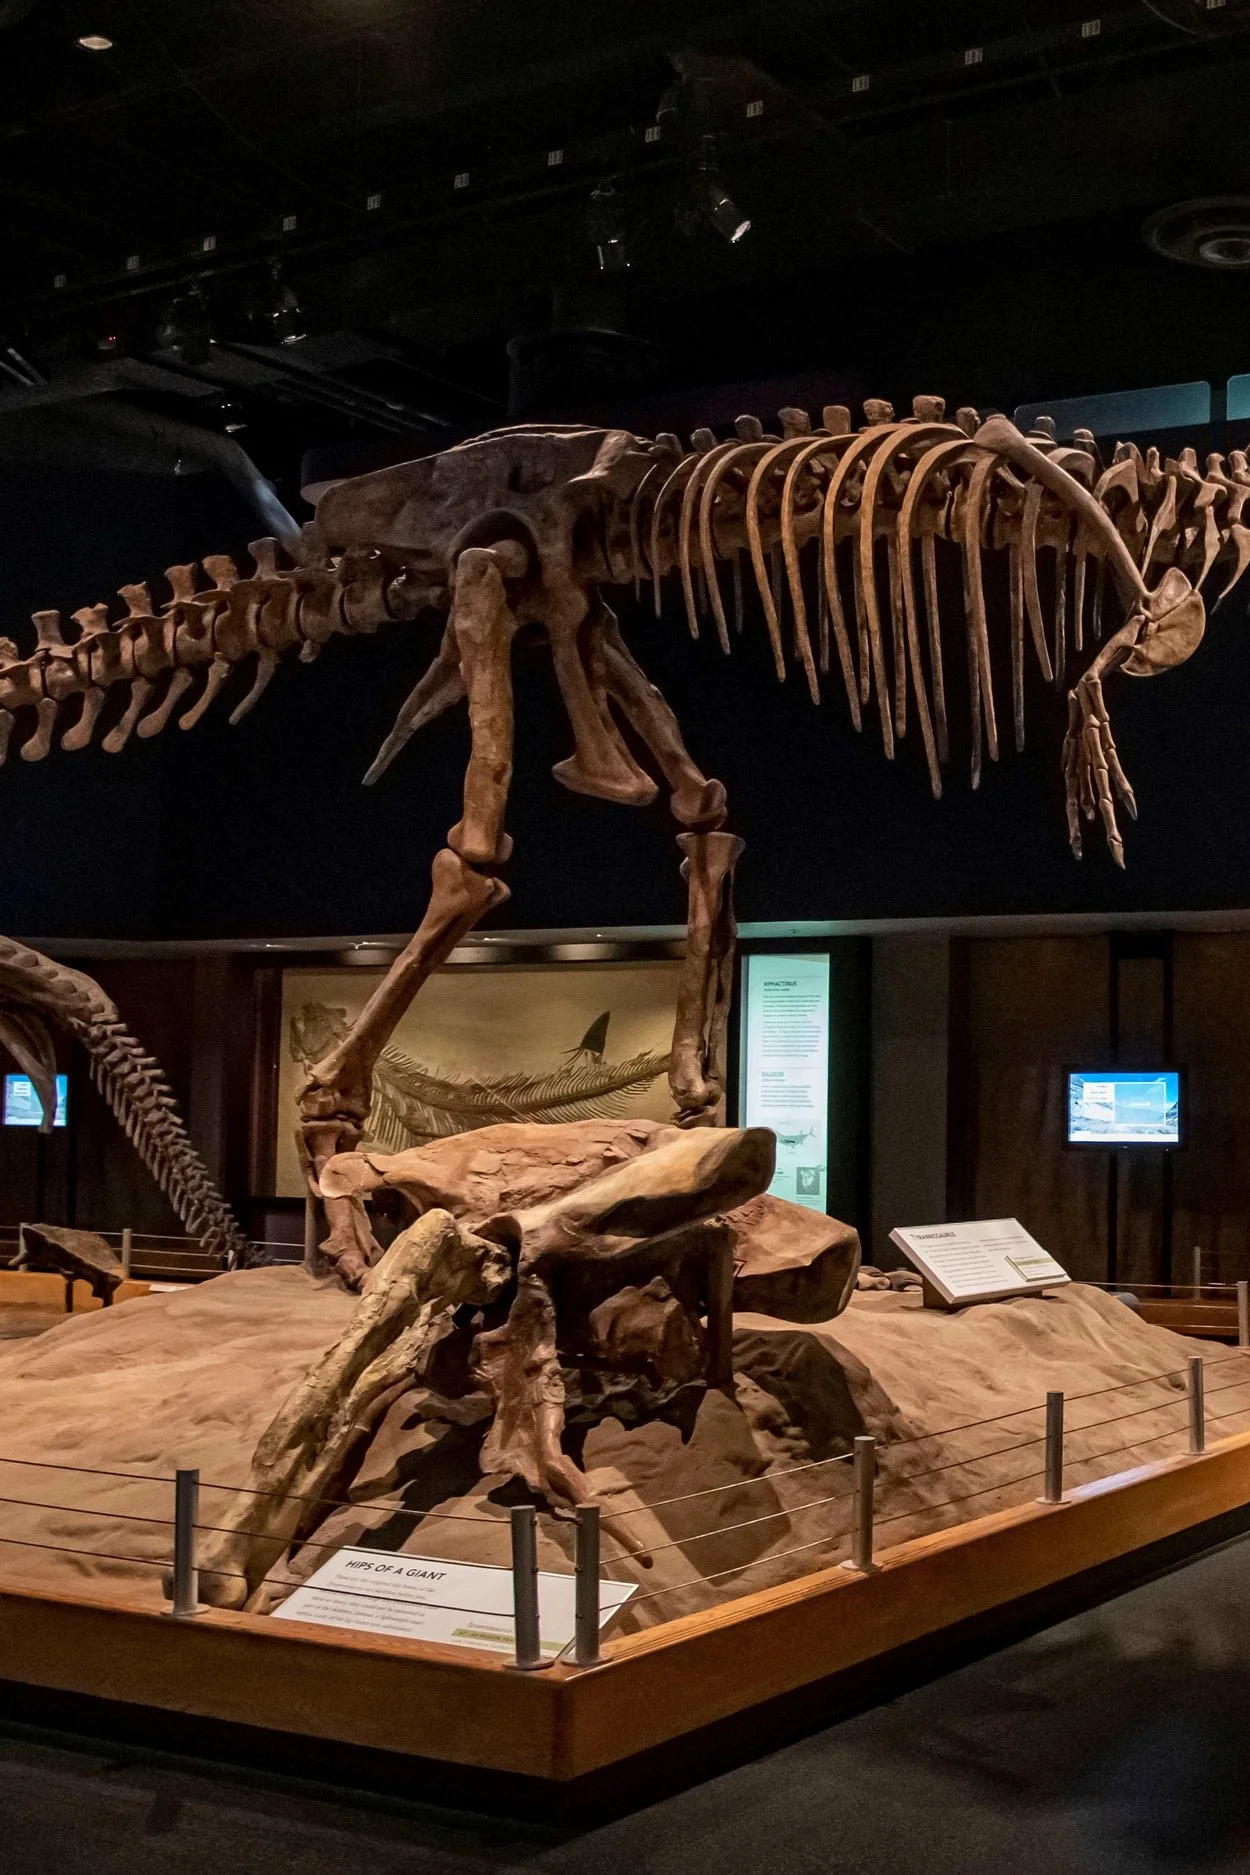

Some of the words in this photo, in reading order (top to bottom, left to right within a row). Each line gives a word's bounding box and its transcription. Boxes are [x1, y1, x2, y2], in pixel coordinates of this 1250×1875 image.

[345, 1560, 375, 1571] HIPS
[375, 1564, 395, 1573] OF
[393, 1567, 405, 1576] A
[406, 1569, 447, 1581] GIANT
